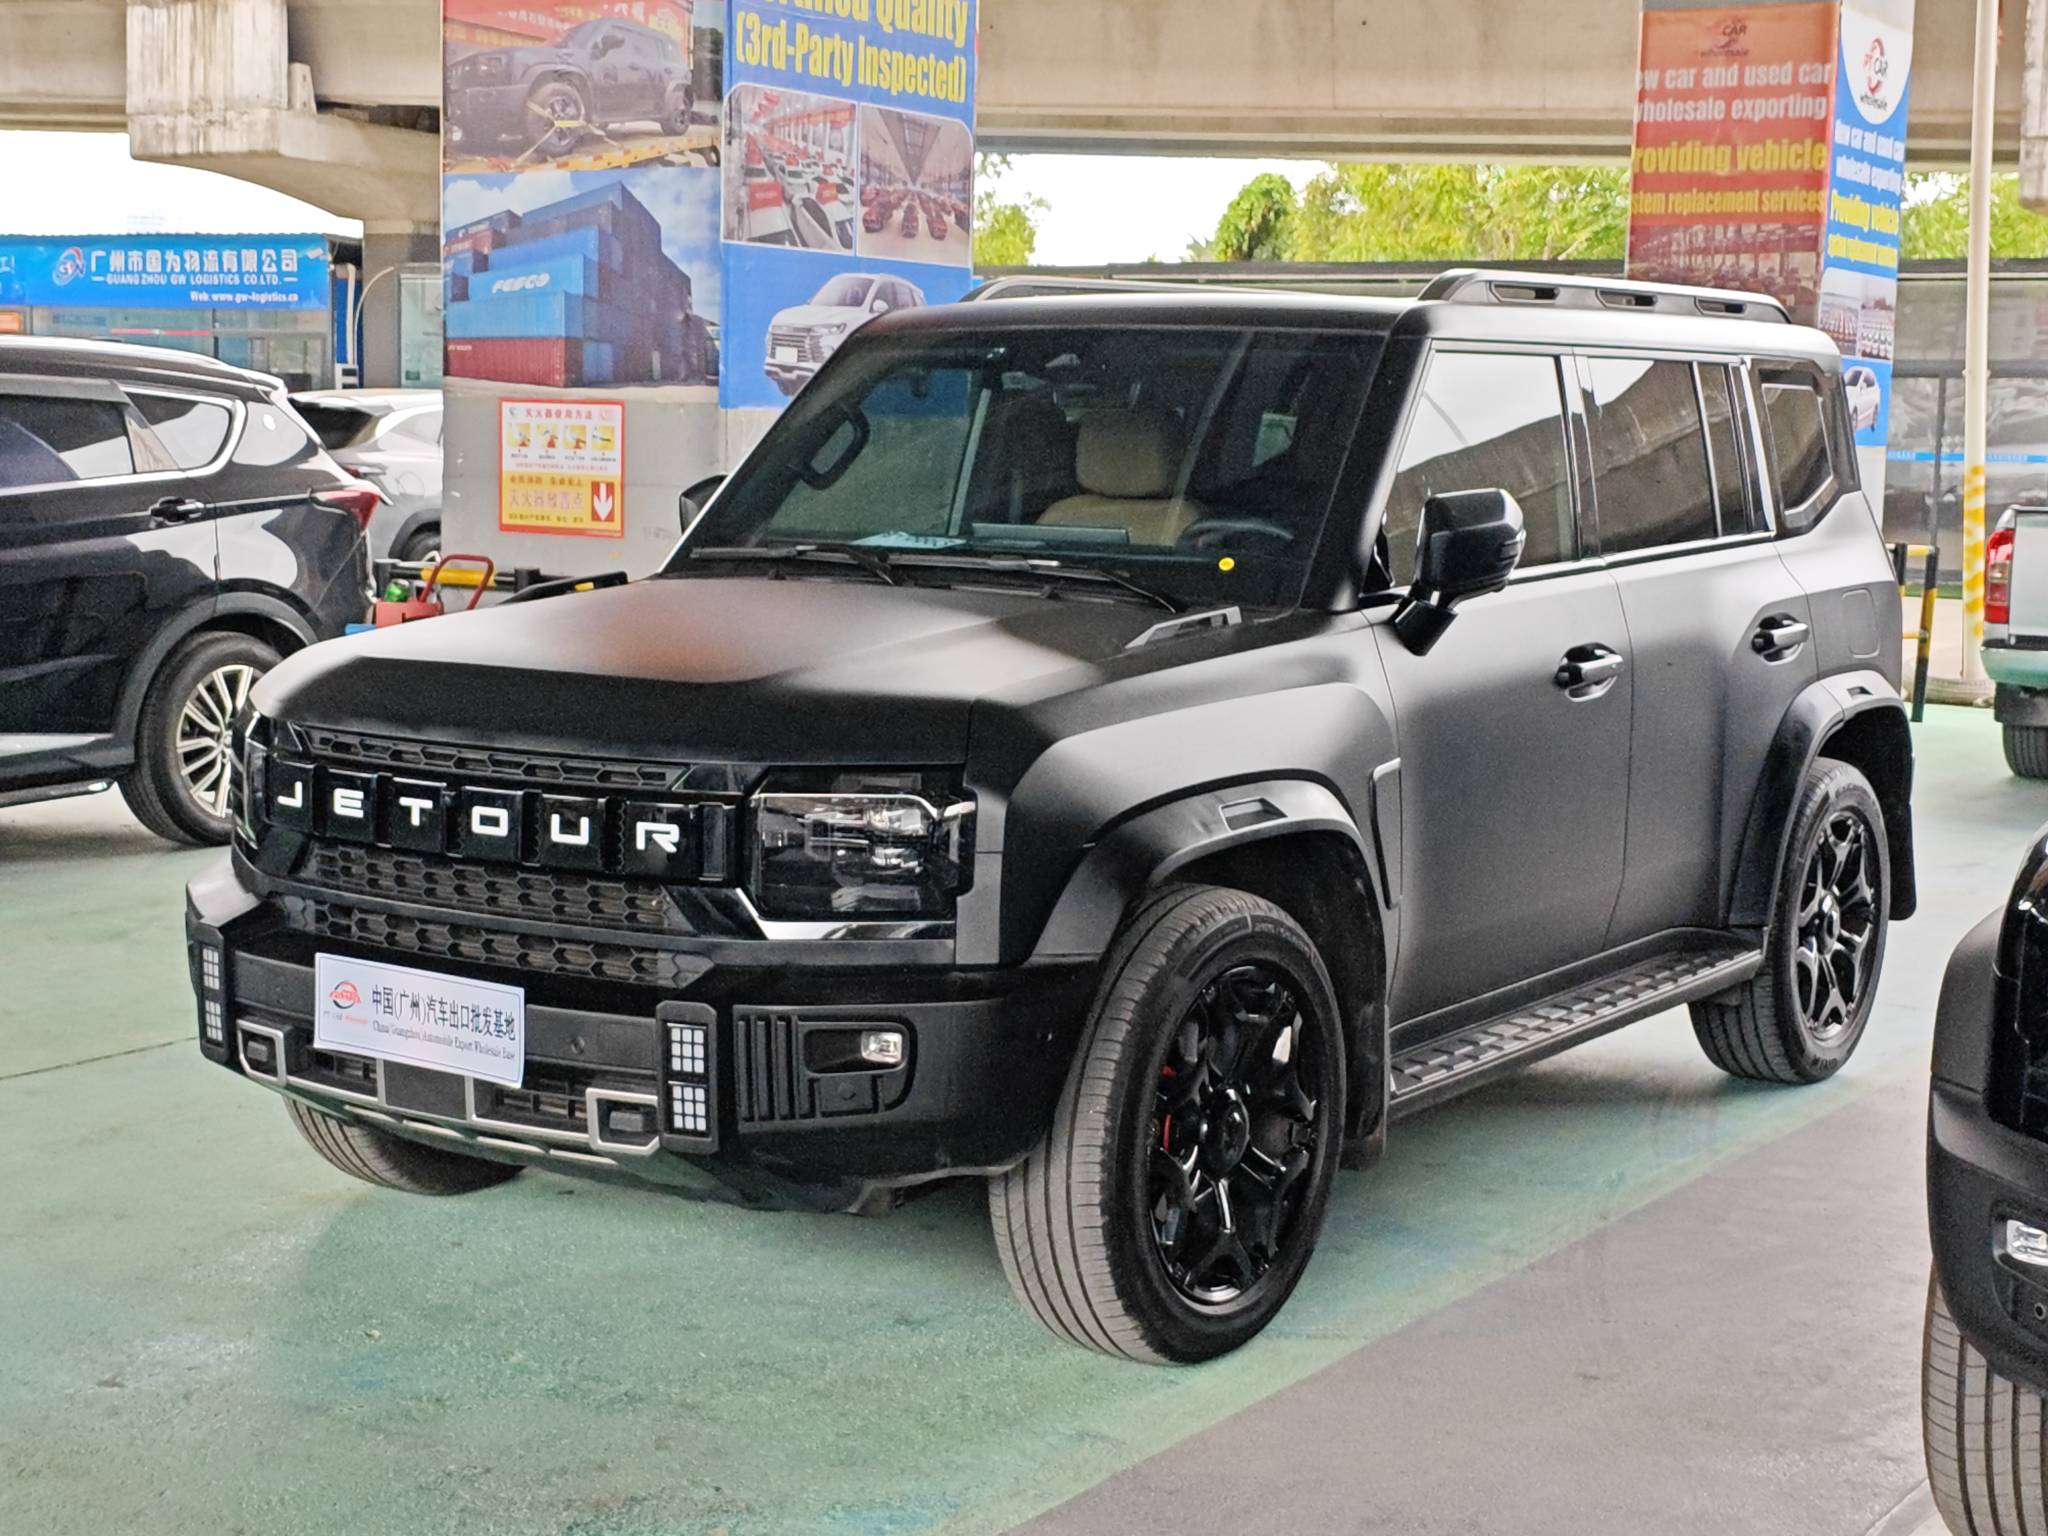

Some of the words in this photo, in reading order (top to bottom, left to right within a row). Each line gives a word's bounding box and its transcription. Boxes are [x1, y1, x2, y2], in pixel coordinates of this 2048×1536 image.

[736, 11, 854, 87] (3rd-Party
[858, 35, 967, 103] Inspected)
[1665, 67, 1697, 89] car
[1702, 63, 1739, 88] and
[1743, 61, 1793, 87] used
[1798, 63, 1831, 85] car
[1730, 94, 1827, 123] exporting
[1736, 136, 1827, 172] vehicle
[1667, 187, 1759, 216] replacement
[1762, 185, 1826, 213] services
[190, 273, 240, 285] LOGISTICS
[277, 780, 680, 854] JETOUR
